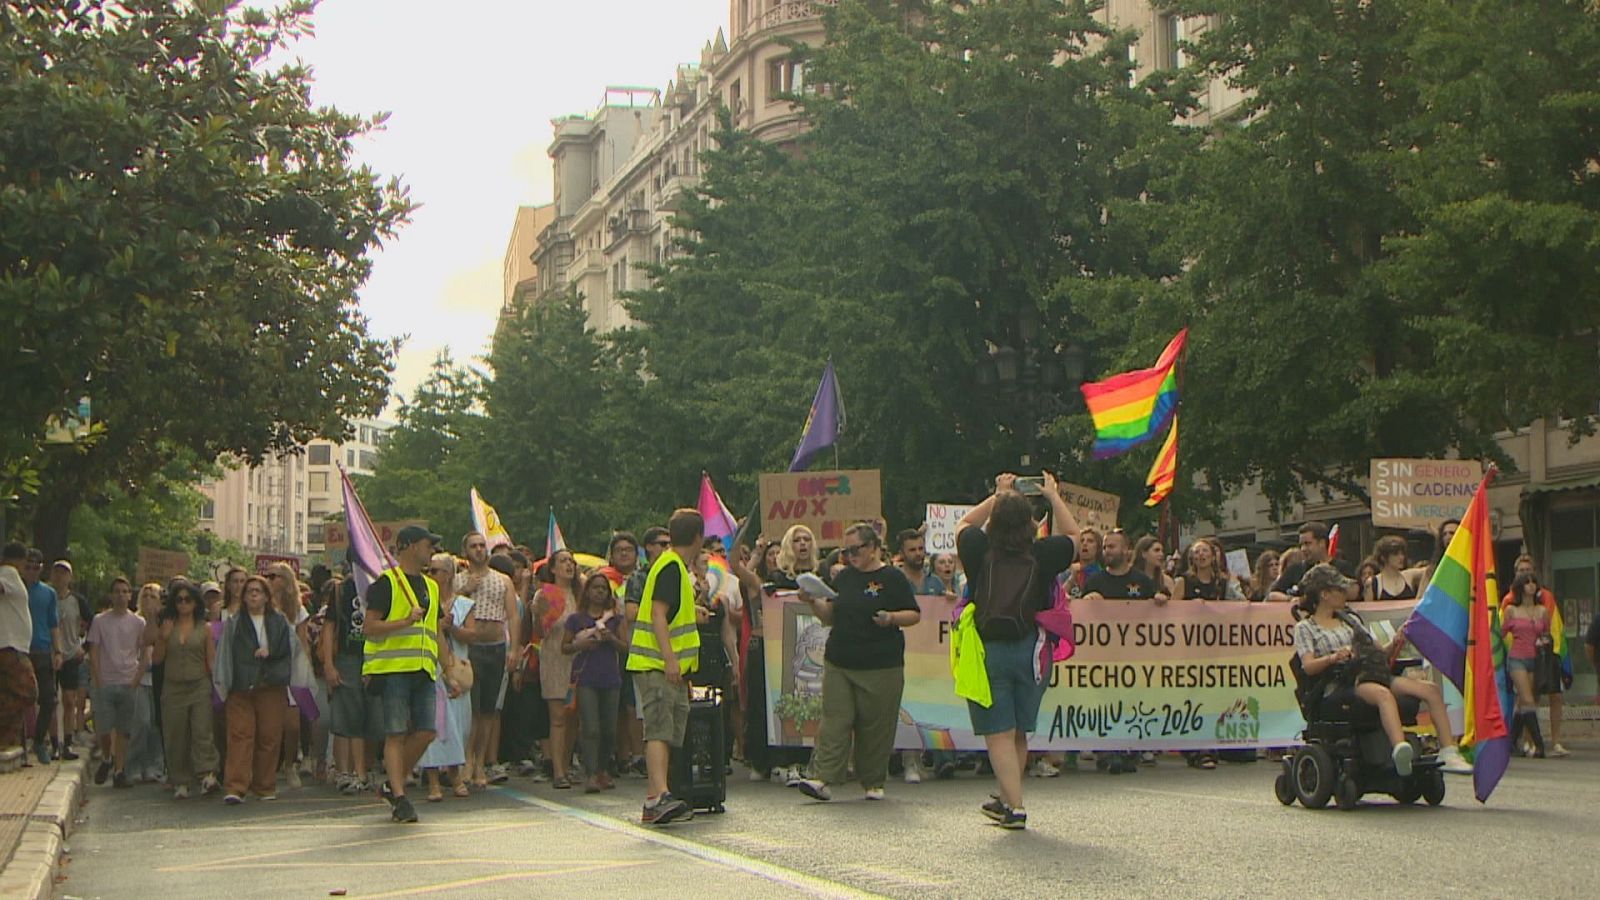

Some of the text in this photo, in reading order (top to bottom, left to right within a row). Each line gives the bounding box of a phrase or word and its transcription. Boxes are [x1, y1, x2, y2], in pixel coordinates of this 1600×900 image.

[1376, 461, 1412, 477] SIN
[1376, 479, 1411, 496] SIN
[768, 498, 829, 520] NO X
[929, 504, 946, 519] NO
[1077, 494, 1103, 513] GUSTA
[1376, 500, 1413, 518] SIN
[1073, 623, 1111, 646] DIO
[1117, 623, 1131, 646] Y
[1135, 623, 1176, 647] SUS
[1181, 623, 1295, 648] VIOLENCIAS
[1066, 665, 1136, 688] TECHO
[1142, 665, 1155, 688] Y
[1162, 665, 1286, 688] RESISTENCIA
[1161, 700, 1204, 736] 2026
[1215, 720, 1260, 740] CNSV
